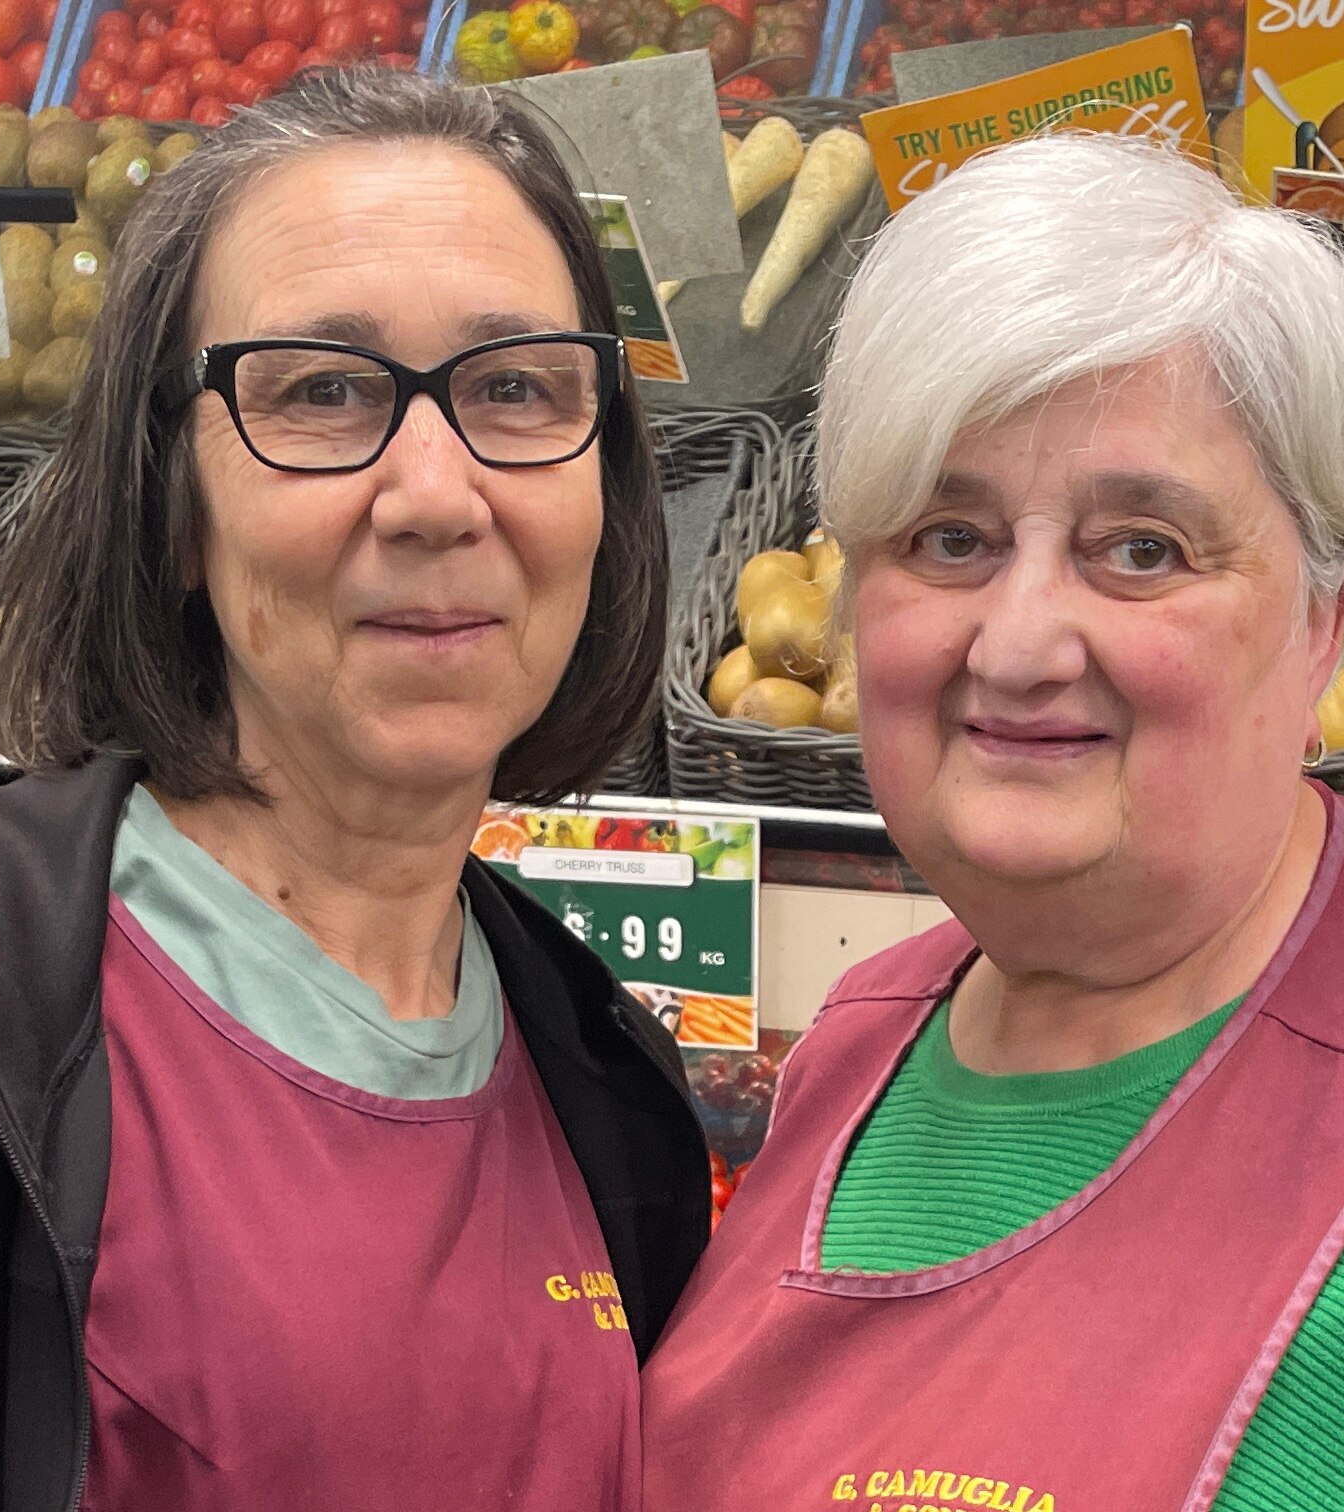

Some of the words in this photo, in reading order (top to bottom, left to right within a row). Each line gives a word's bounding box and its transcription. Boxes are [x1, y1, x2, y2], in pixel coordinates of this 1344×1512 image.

[894, 128, 942, 159] TRY
[949, 115, 1001, 150] THE
[1008, 66, 1174, 137] SURPRISING
[555, 859, 603, 872] CHERRY
[606, 861, 646, 875] TRUSS
[700, 952, 726, 966] KG
[546, 1274, 581, 1301] G.
[832, 1474, 858, 1500] G.
